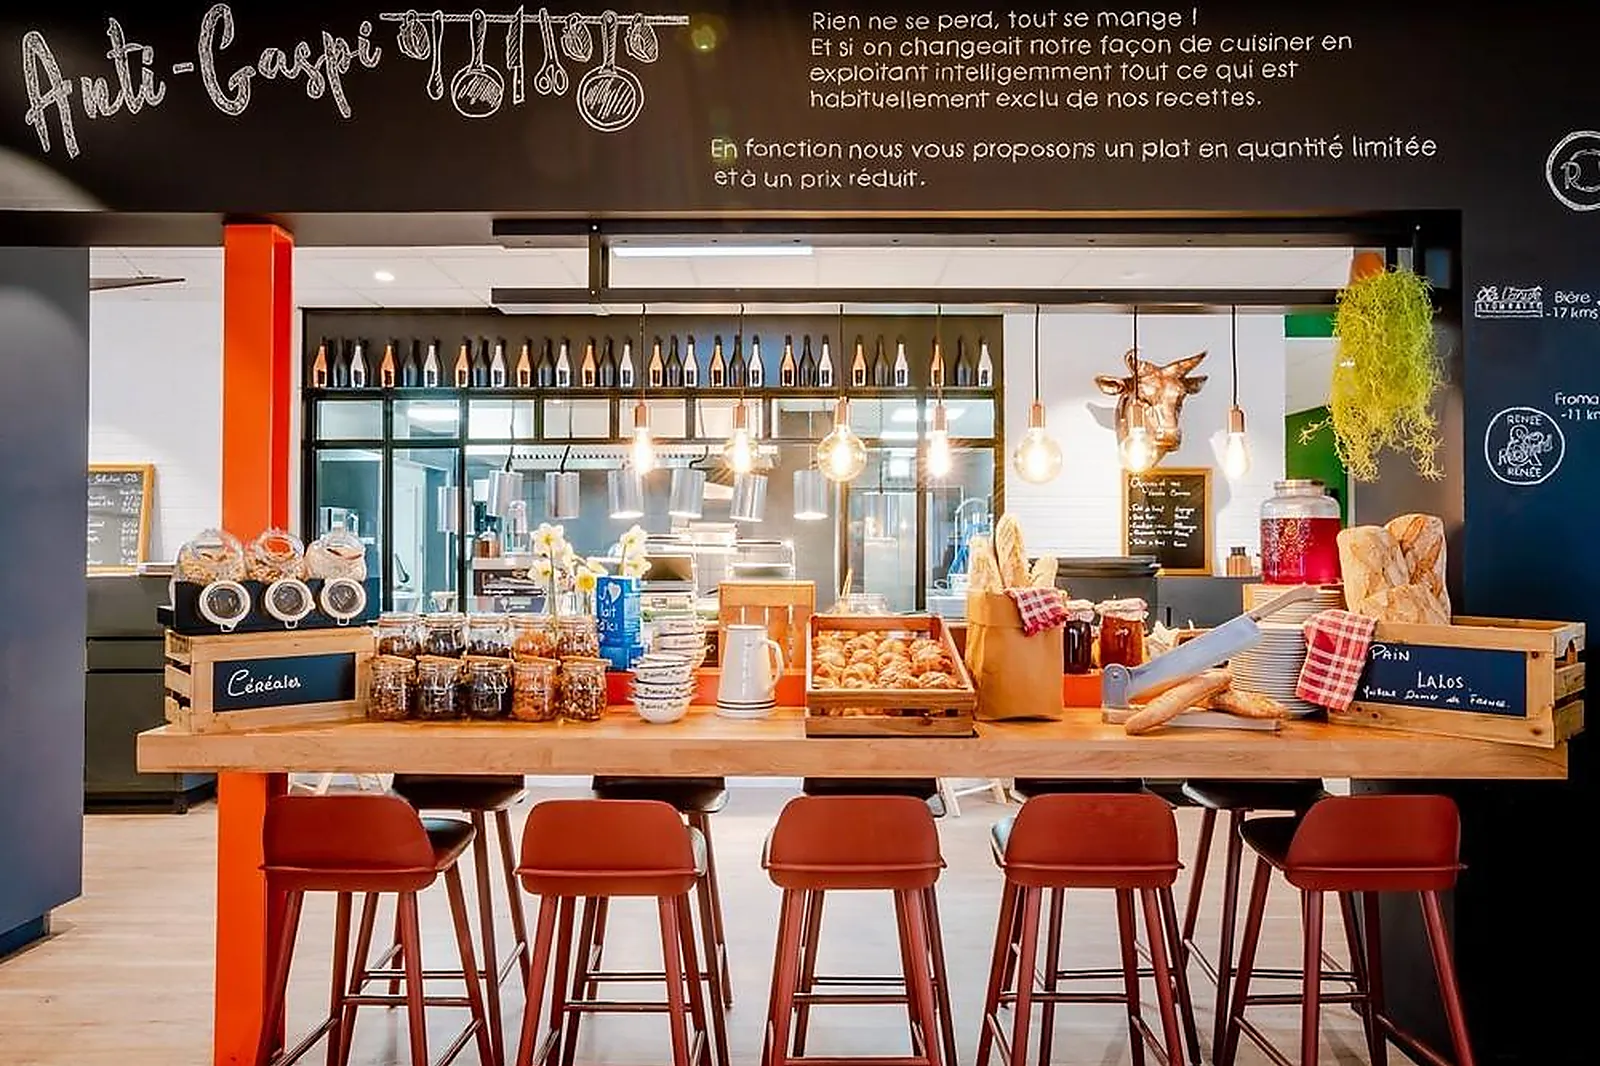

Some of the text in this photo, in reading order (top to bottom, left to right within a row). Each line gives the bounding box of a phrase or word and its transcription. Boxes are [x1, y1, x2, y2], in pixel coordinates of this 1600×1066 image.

[812, 7, 1198, 33] Rien ne se perd, tout se mange !
[811, 33, 1352, 61] Et si on changeait notre façon de cuisiner en
[22, 4, 382, 159] Anti-Gaspi
[809, 59, 1299, 87] exploitant intelligemment tout ce qui est
[810, 88, 1262, 111] habituellement exclu de nos recettes.
[711, 135, 1437, 163] En fonction nous vous proposons un plat en quantité limitée
[763, 171, 793, 188] un
[800, 169, 843, 190] prix
[849, 167, 926, 188] réduit.
[1554, 290, 1591, 304] Bière
[1570, 306, 1599, 319] kms
[1417, 671, 1465, 689] LALOS
